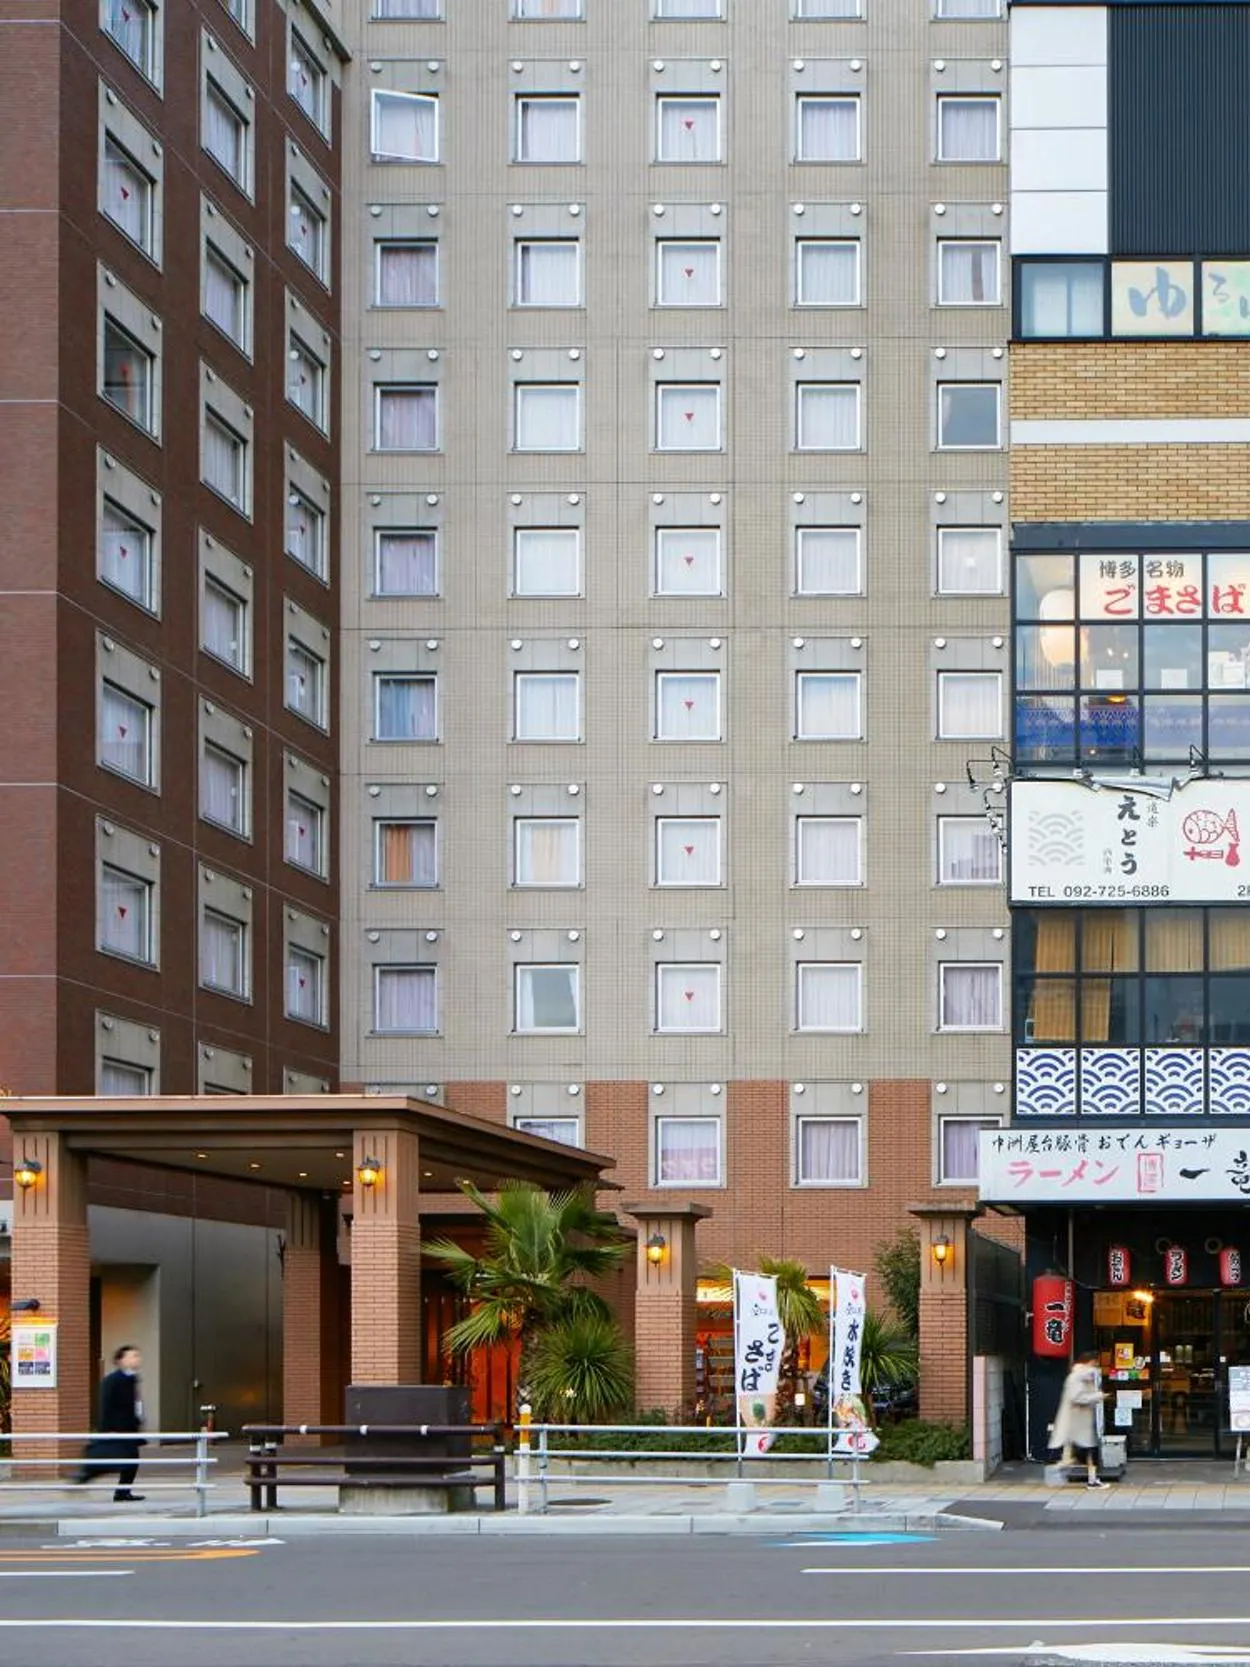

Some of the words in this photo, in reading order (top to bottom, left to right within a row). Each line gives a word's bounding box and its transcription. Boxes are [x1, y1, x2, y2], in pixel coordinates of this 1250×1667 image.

[1100, 560, 1185, 579] 博多名物
[1104, 583, 1246, 615] ごまさば
[1118, 795, 1140, 875] えとう
[1028, 886, 1055, 898] TEL
[1063, 885, 1169, 898] 092-725-6886
[1098, 1132, 1149, 1150] おでん
[1156, 1133, 1217, 1149] ギョーザ
[1009, 1159, 1120, 1187] ラーメン
